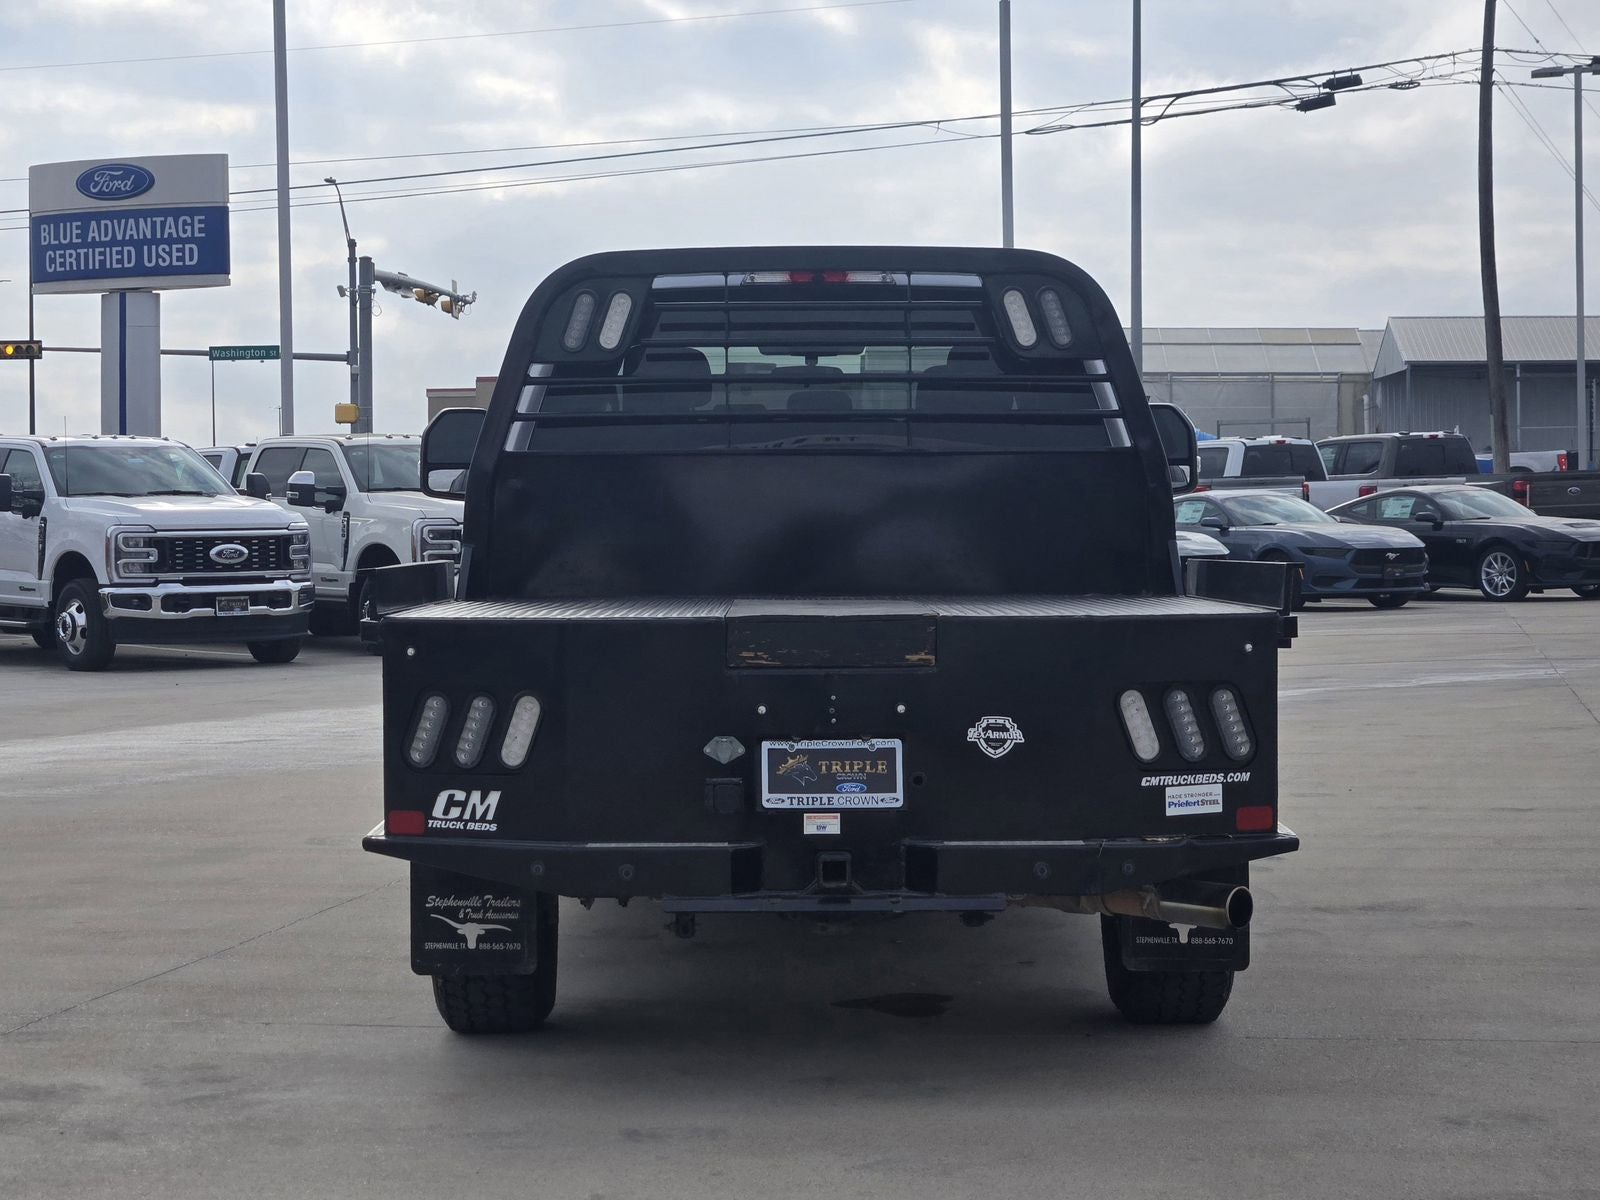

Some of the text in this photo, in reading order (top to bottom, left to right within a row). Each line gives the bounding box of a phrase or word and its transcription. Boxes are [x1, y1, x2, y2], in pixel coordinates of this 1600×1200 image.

[90, 170, 135, 193] Ford
[40, 215, 206, 246] BLUE ADVANTAGE
[45, 243, 199, 272] CERTIFIED USED
[211, 348, 266, 359] Washington
[769, 739, 896, 748] wwwTripleCrownFordcom
[818, 760, 888, 775] TRIPLE
[1140, 772, 1251, 787] CMTRUCKBEDS.COM
[841, 784, 861, 793] Ford
[432, 789, 502, 821] CM
[787, 796, 880, 806] TRIPLE CROWN
[428, 819, 498, 832] TRUCK BEDS
[425, 894, 521, 909] Stephenville Trailers
[458, 908, 465, 919] &
[466, 908, 483, 919] Truck
[479, 942, 521, 950] 888-565-7670
[1190, 937, 1234, 945] 888-565-7670
